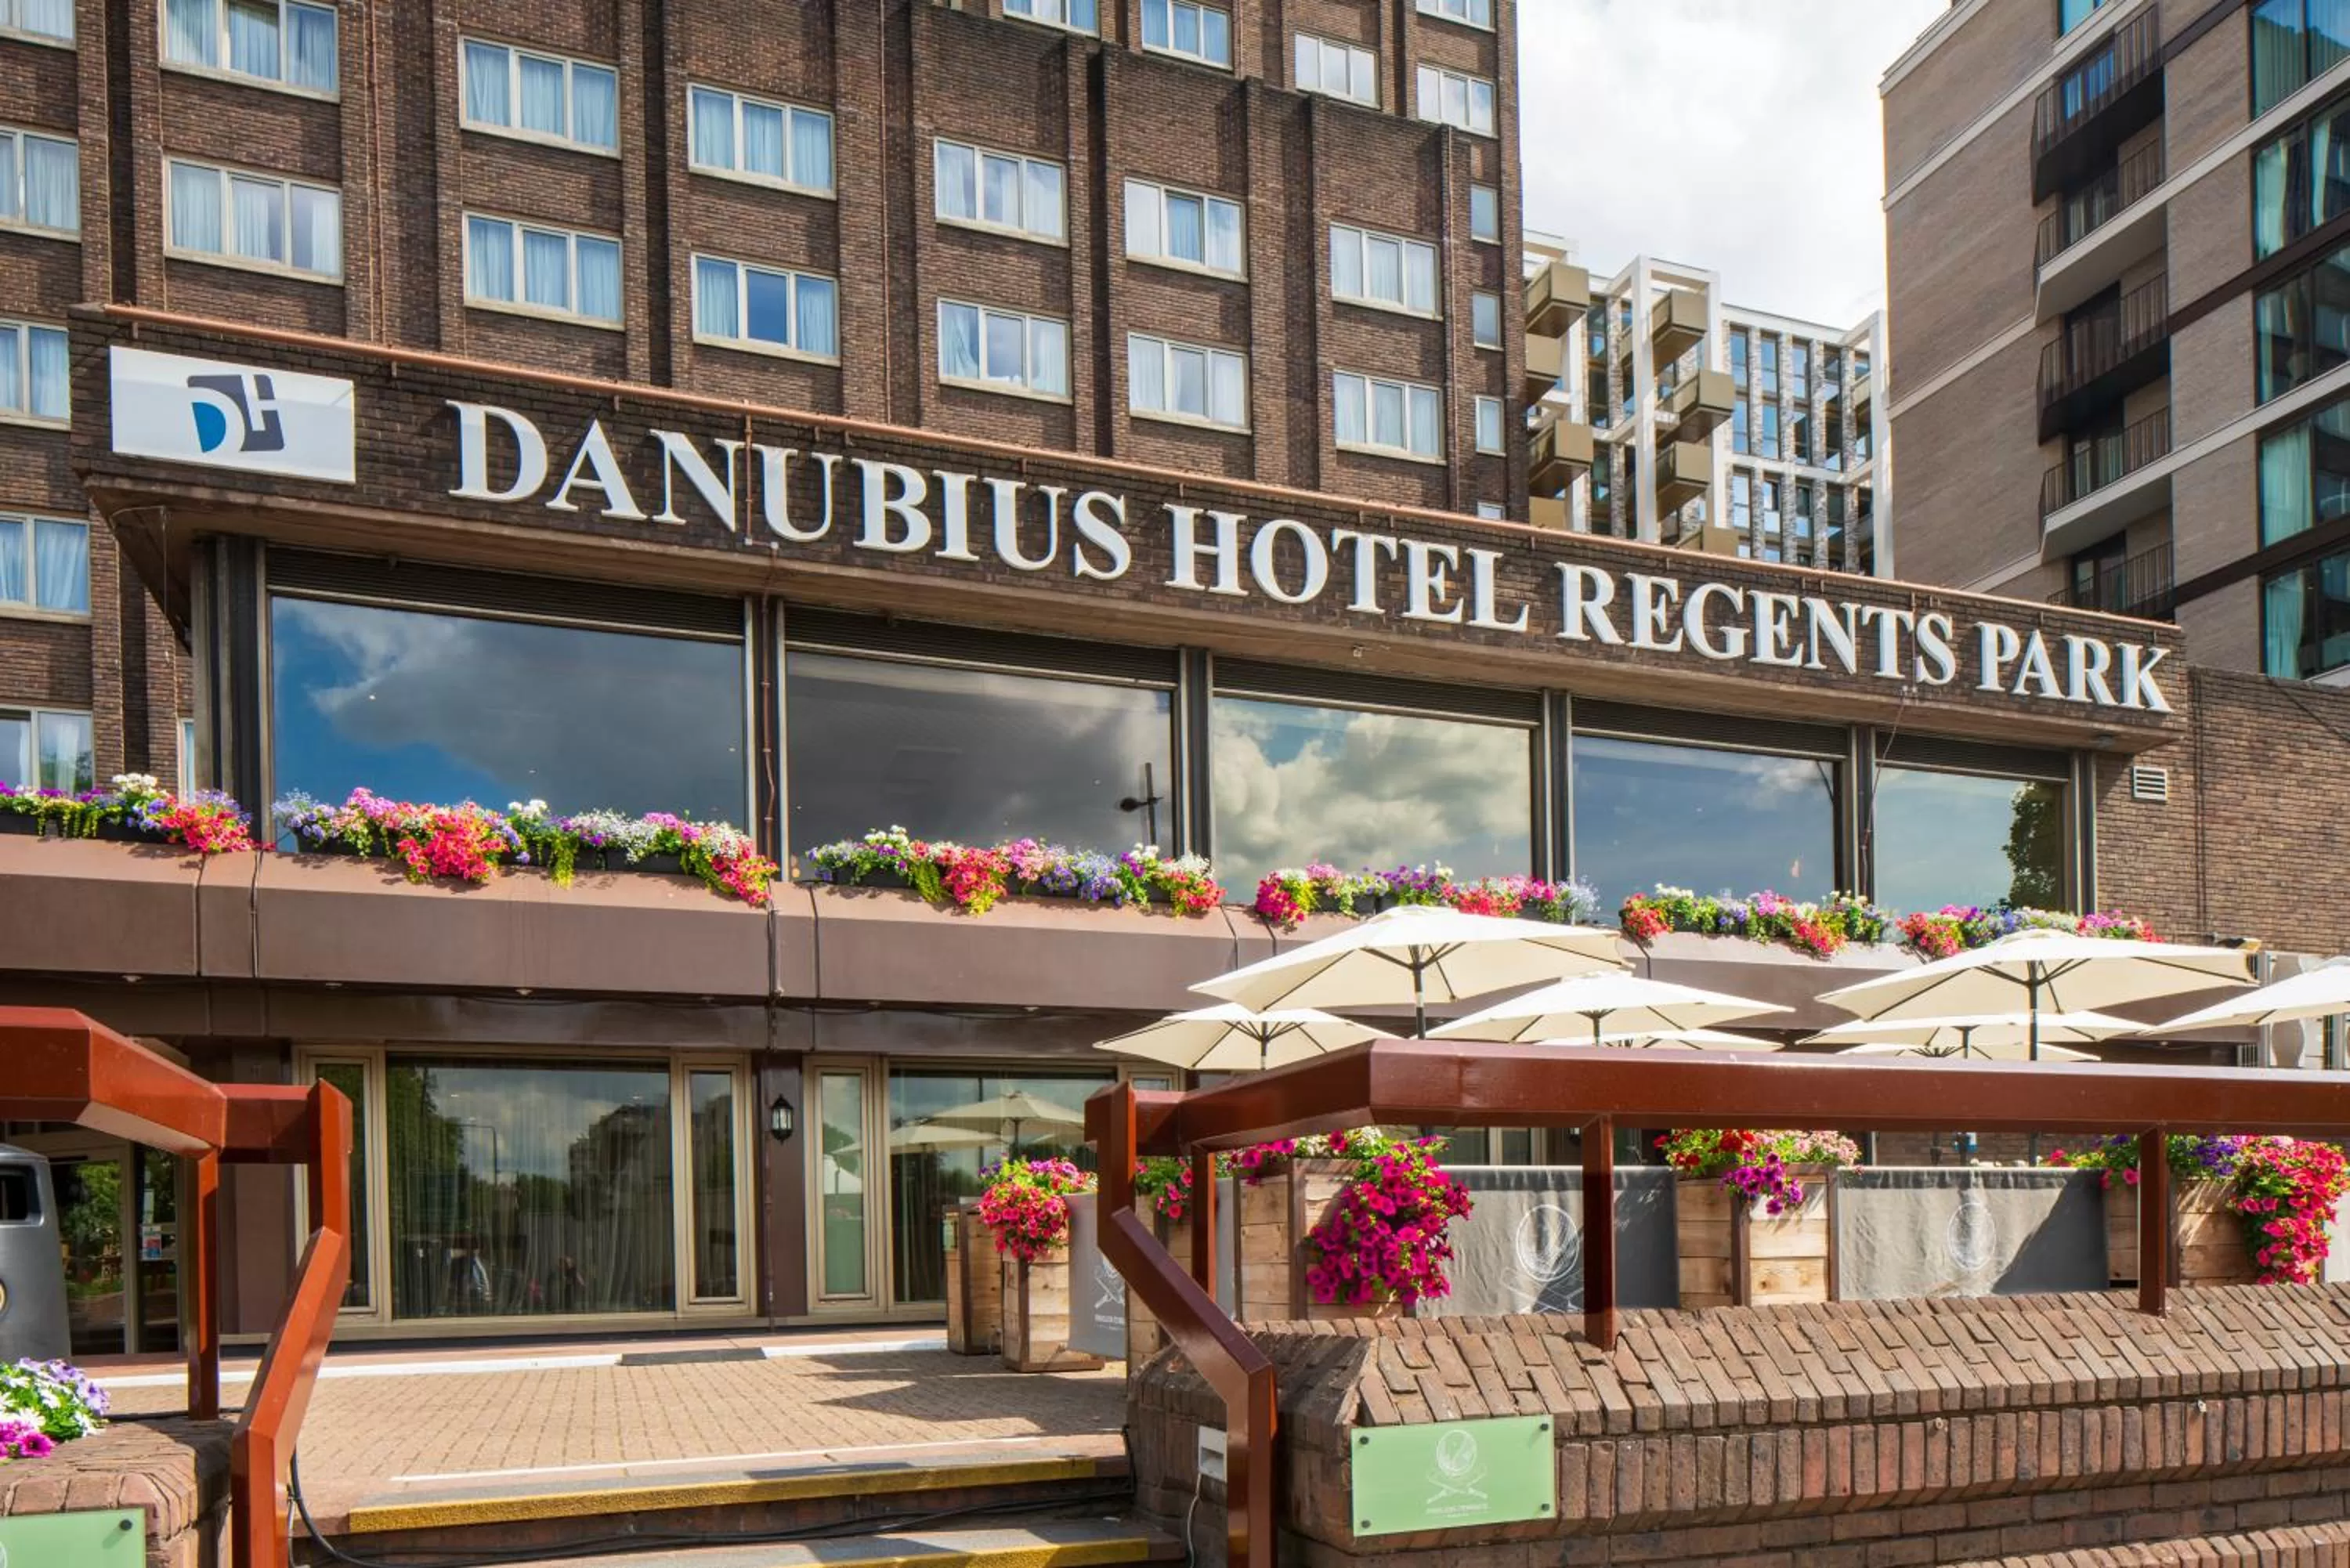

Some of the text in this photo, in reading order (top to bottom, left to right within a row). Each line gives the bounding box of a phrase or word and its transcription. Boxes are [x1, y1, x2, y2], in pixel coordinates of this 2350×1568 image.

[446, 400, 2175, 714] DANUBIUS HOTEL REGENTS PARK
